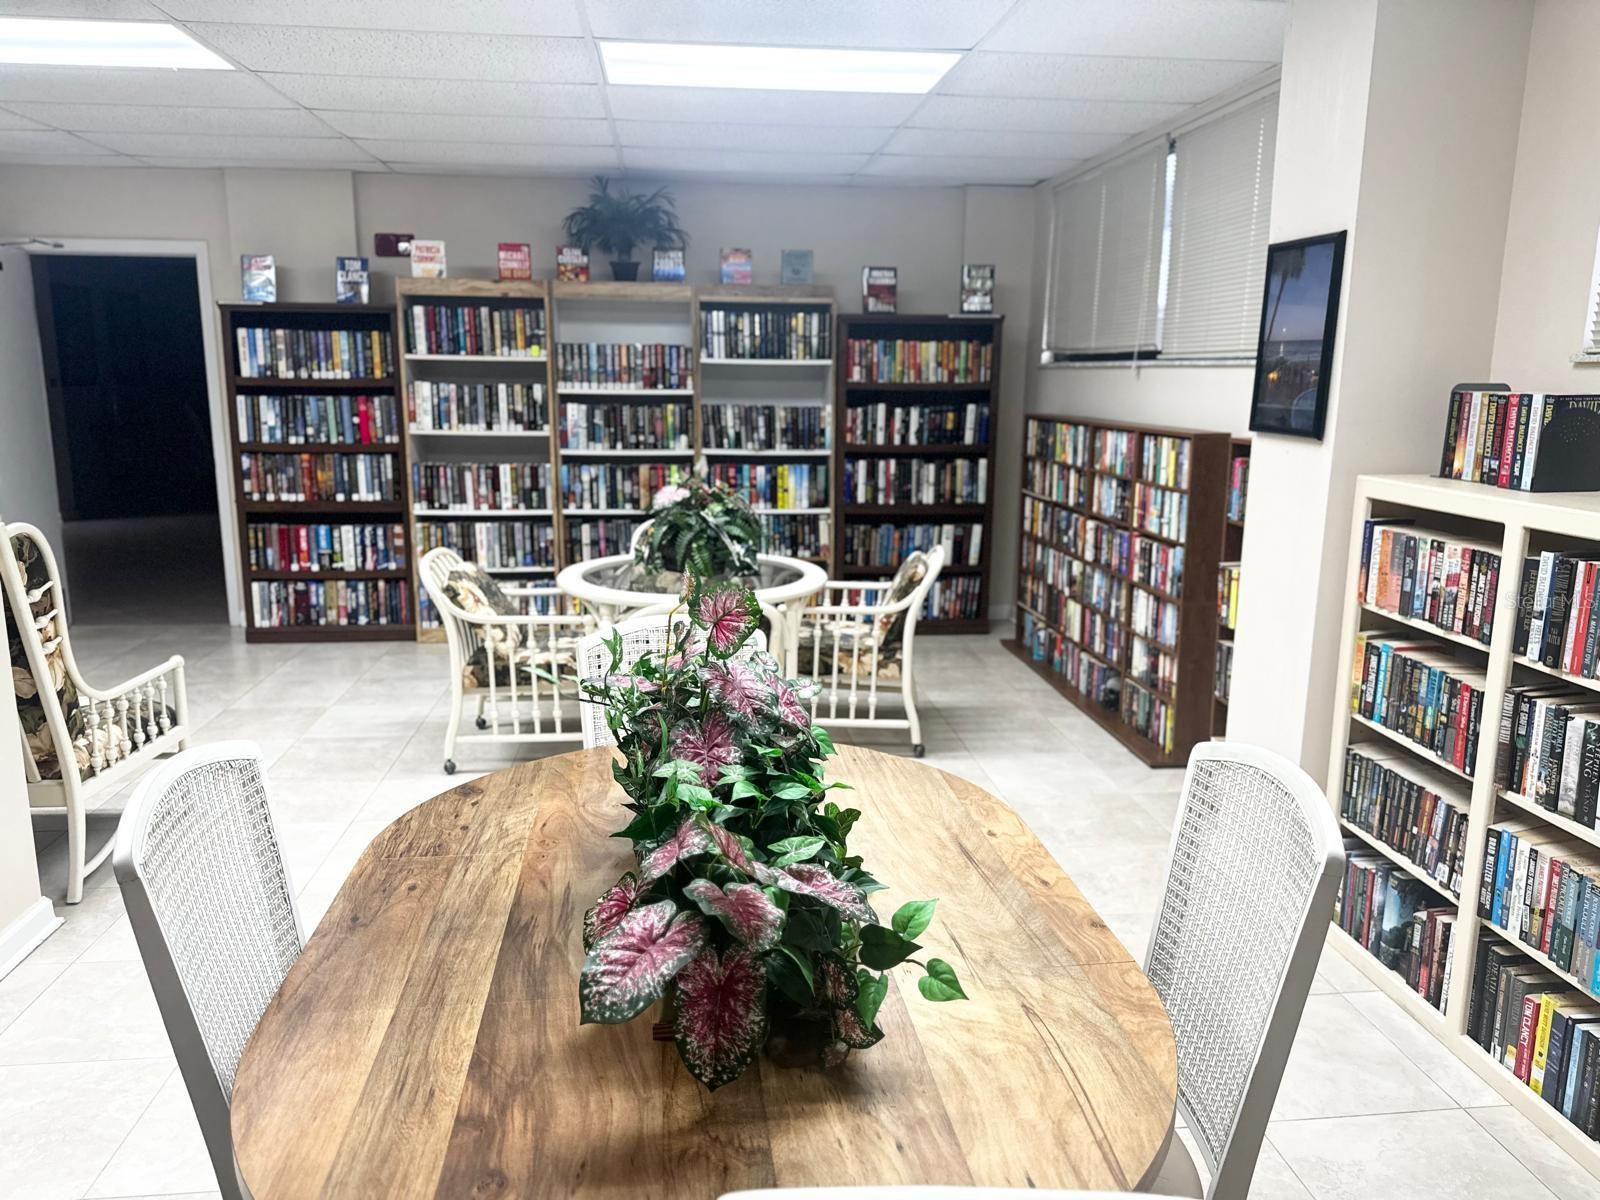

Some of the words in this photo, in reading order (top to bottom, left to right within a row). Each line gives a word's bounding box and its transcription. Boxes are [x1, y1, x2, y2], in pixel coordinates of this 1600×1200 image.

[1505, 429, 1513, 463] BALDACCI
[1541, 555, 1549, 575] DAVID
[1557, 716, 1565, 753] VICTORIA
[1584, 744, 1594, 778] KING
[1592, 743, 1600, 784] STEPHEN
[1488, 837, 1497, 855] BRAD
[1485, 855, 1494, 882] MELTZER
[1561, 866, 1569, 885] JODI
[1558, 885, 1566, 915] PICOULT
[1584, 881, 1592, 901] JODI
[1489, 962, 1499, 994] DEATH
[1524, 1001, 1533, 1016] TOM
[1520, 1017, 1531, 1047] CLANCY
